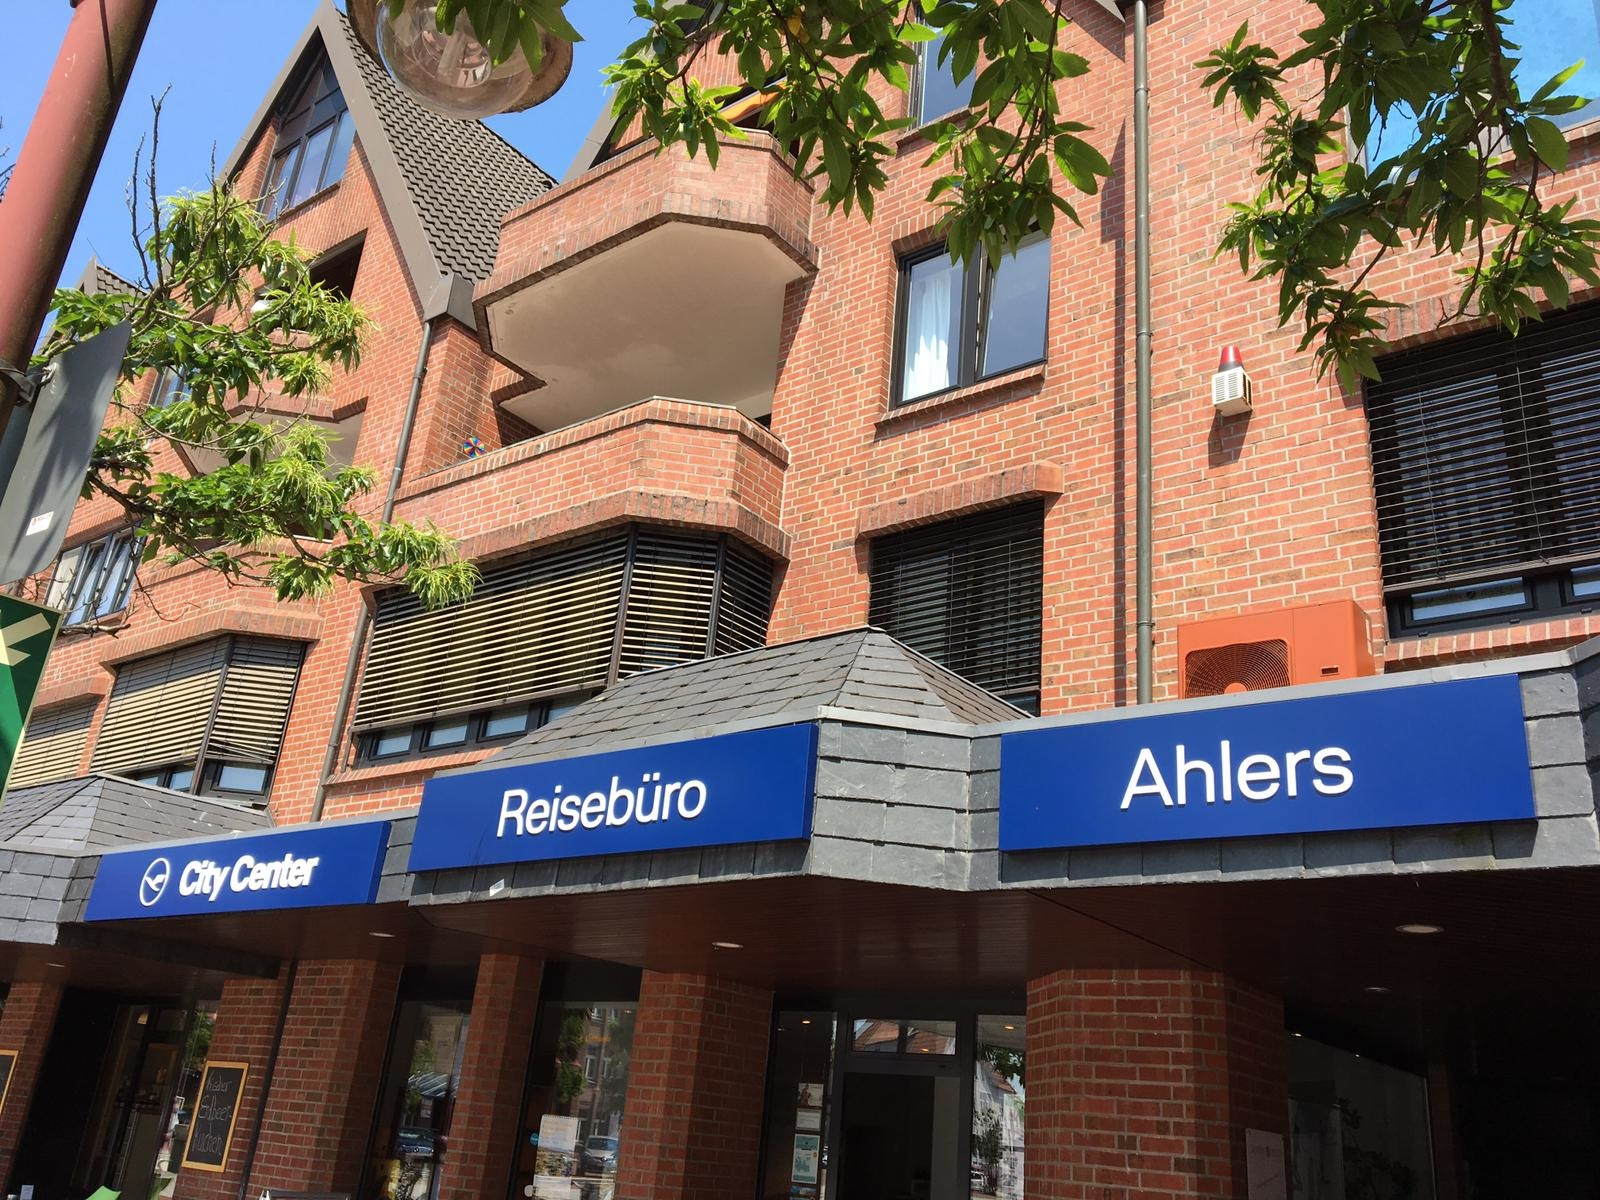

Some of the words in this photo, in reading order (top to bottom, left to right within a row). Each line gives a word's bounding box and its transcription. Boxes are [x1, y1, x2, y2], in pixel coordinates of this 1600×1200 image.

[496, 772, 708, 838] Reisebüro
[1119, 739, 1355, 810] Ahlers
[178, 859, 232, 902] City
[229, 852, 321, 893] Center
